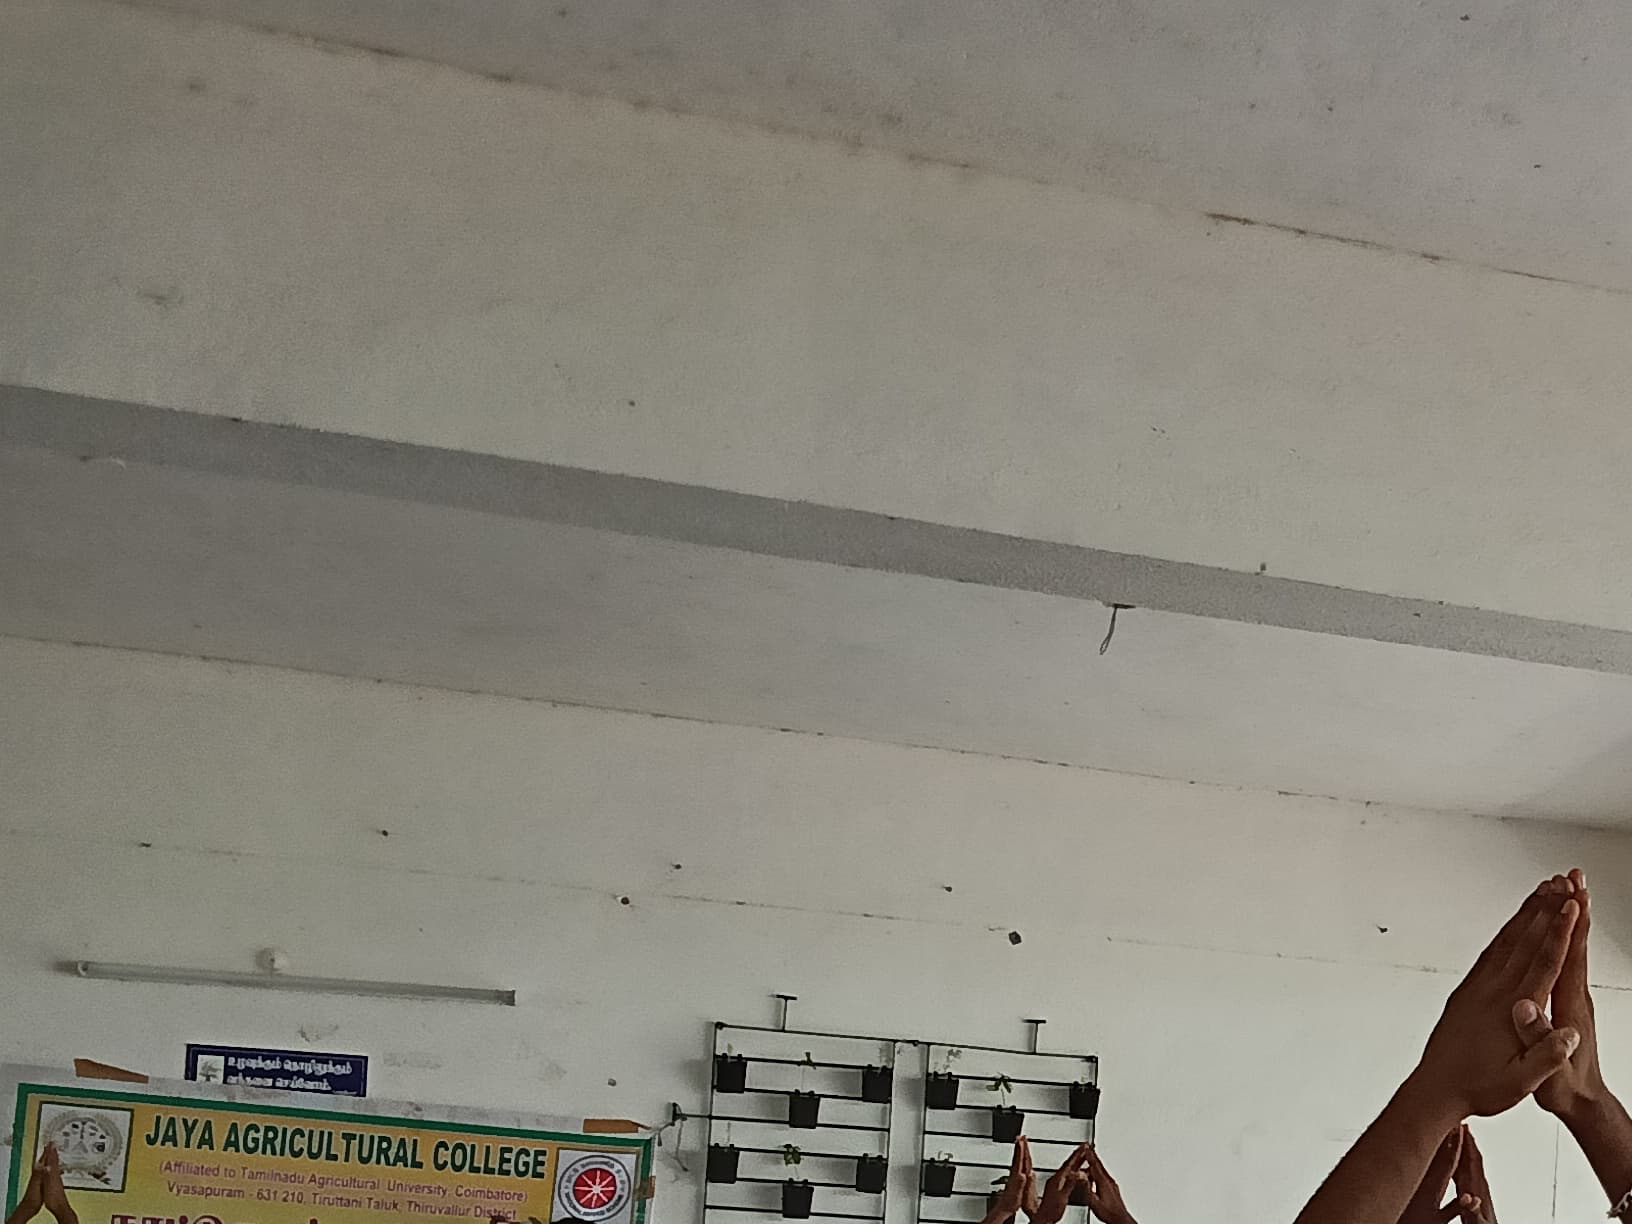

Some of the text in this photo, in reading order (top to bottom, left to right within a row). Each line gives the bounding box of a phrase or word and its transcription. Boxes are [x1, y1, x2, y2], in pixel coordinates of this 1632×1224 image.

[146, 1115, 547, 1179] JAYA AGRICULTURAL COLLEGE
[159, 1160, 220, 1178] (Affiliated
[224, 1165, 236, 1178] to
[241, 1166, 304, 1184] Tamilnadu
[308, 1173, 380, 1191] Agricultural
[455, 1184, 528, 1202] Coimbatore)
[168, 1180, 245, 1199] Vyasapuram
[256, 1188, 278, 1201] 631
[312, 1192, 362, 1208] Tiruttani
[407, 1200, 471, 1217] Thiruvallur
[474, 1205, 517, 1221] District
